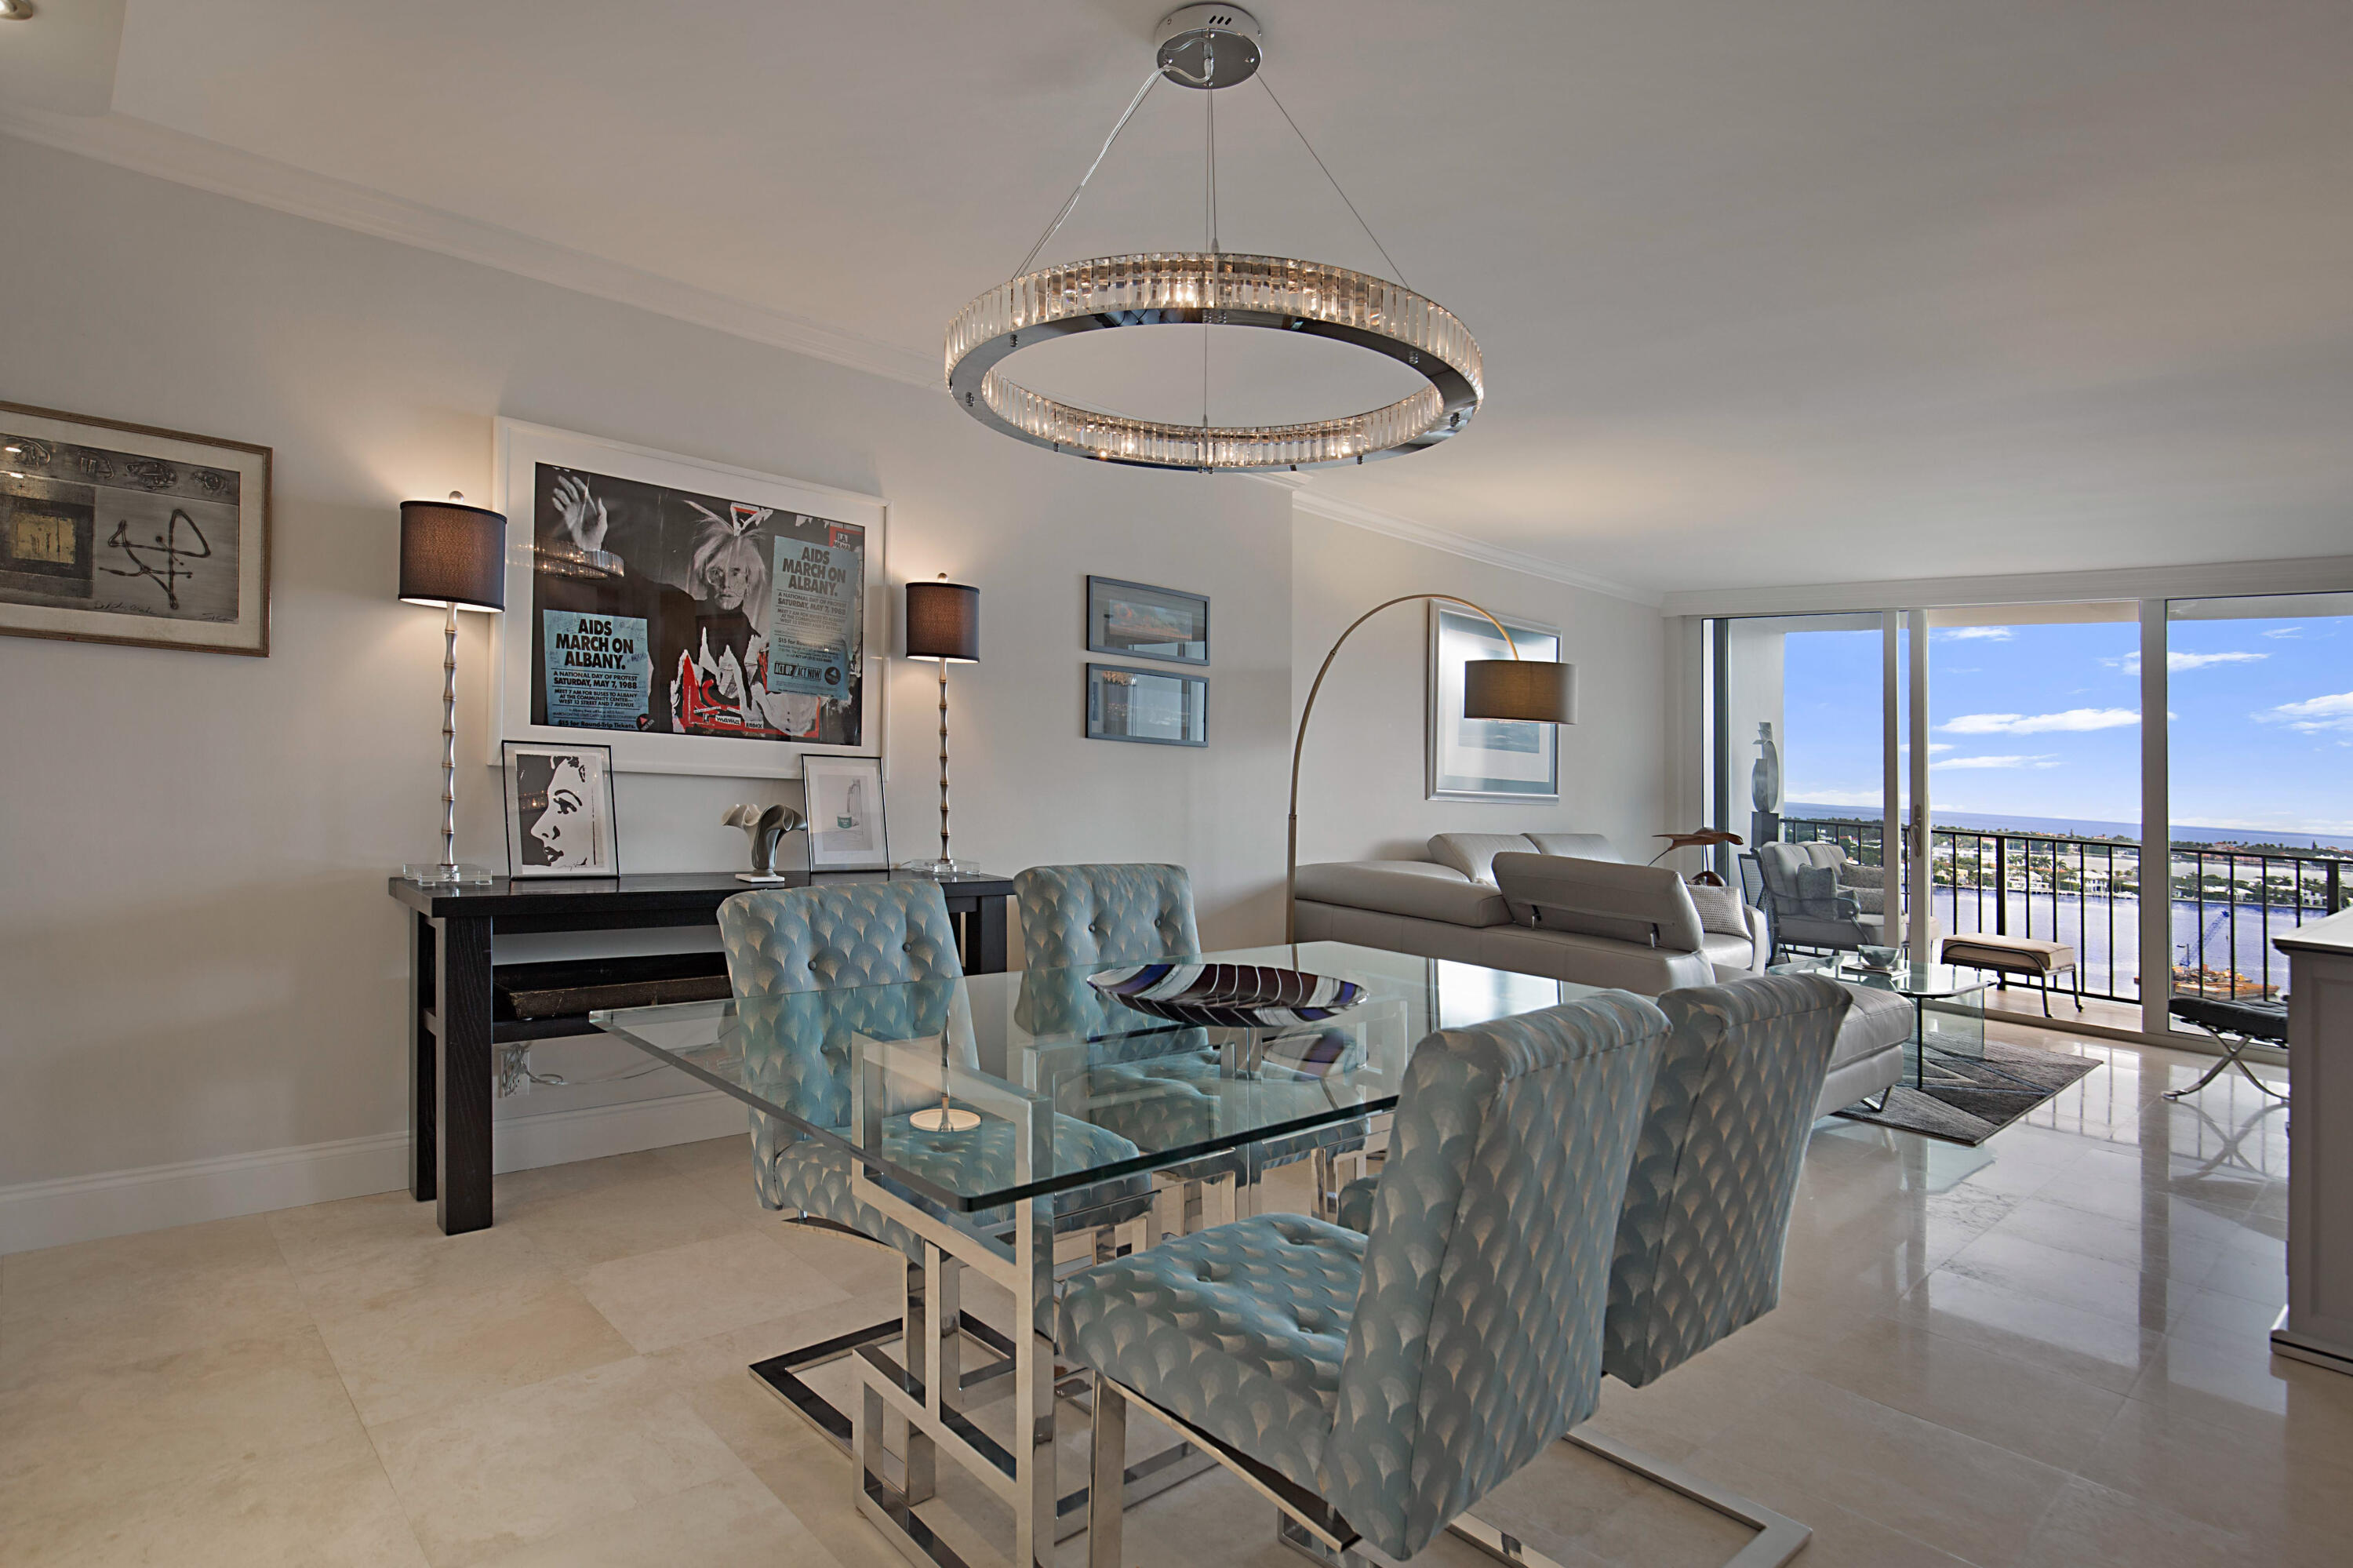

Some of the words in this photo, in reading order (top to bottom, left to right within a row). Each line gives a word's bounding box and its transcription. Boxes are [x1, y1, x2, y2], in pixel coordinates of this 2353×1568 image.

[801, 546, 830, 565] AIDS
[782, 558, 826, 579] MARCH
[828, 567, 846, 583] ON
[788, 575, 838, 596] ALBANY.
[778, 597, 809, 610] SATURDAY,
[810, 603, 824, 611] MAY
[783, 593, 808, 601] NATIONAL
[578, 619, 613, 636] AIDS
[556, 633, 609, 652] MARCH
[612, 638, 634, 654] ON
[565, 651, 626, 670] ALBANY.
[775, 663, 784, 674] ACT
[808, 668, 821, 680] NOW
[554, 677, 591, 687] SATURDAY,
